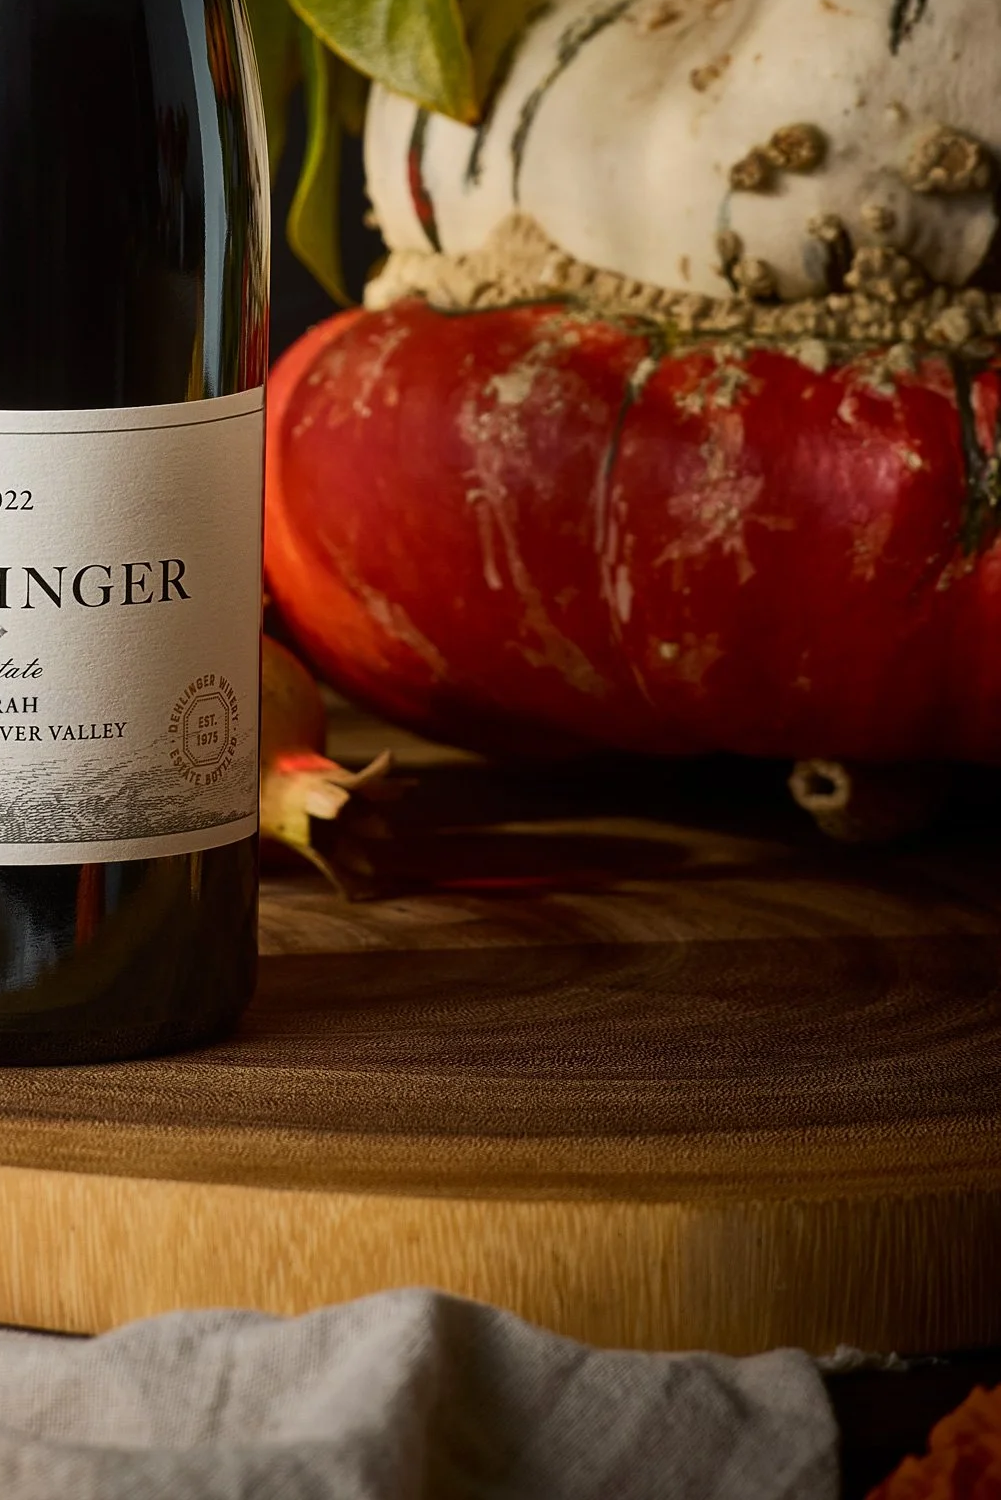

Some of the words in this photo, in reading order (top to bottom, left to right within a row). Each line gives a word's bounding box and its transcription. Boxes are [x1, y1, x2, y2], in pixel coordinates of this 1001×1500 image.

[168, 674, 216, 733] DEHLINGER
[218, 676, 239, 721] WINERY
[47, 721, 128, 741] VALLEY
[198, 713, 218, 729] EST.
[196, 731, 219, 746] 1975
[169, 748, 202, 786] ESTATE
[205, 737, 238, 786] BOTTLED
